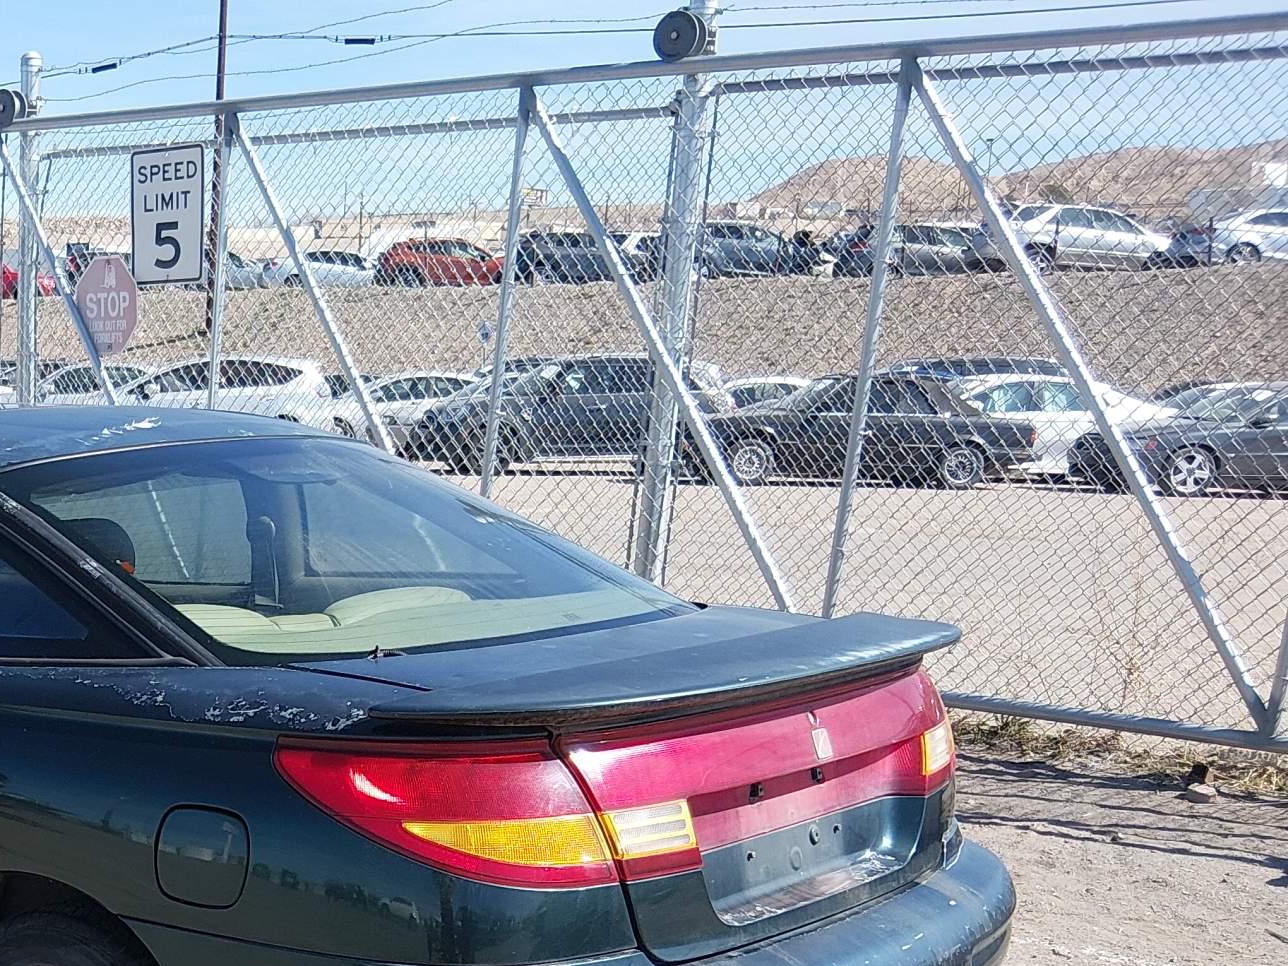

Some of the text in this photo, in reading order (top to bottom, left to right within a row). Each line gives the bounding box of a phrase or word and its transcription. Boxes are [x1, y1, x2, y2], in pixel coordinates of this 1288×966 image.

[137, 160, 198, 184] SPEED
[143, 190, 191, 213] LIMIT
[153, 220, 182, 270] 5
[85, 291, 130, 319] STOP
[104, 320, 116, 331] OUT
